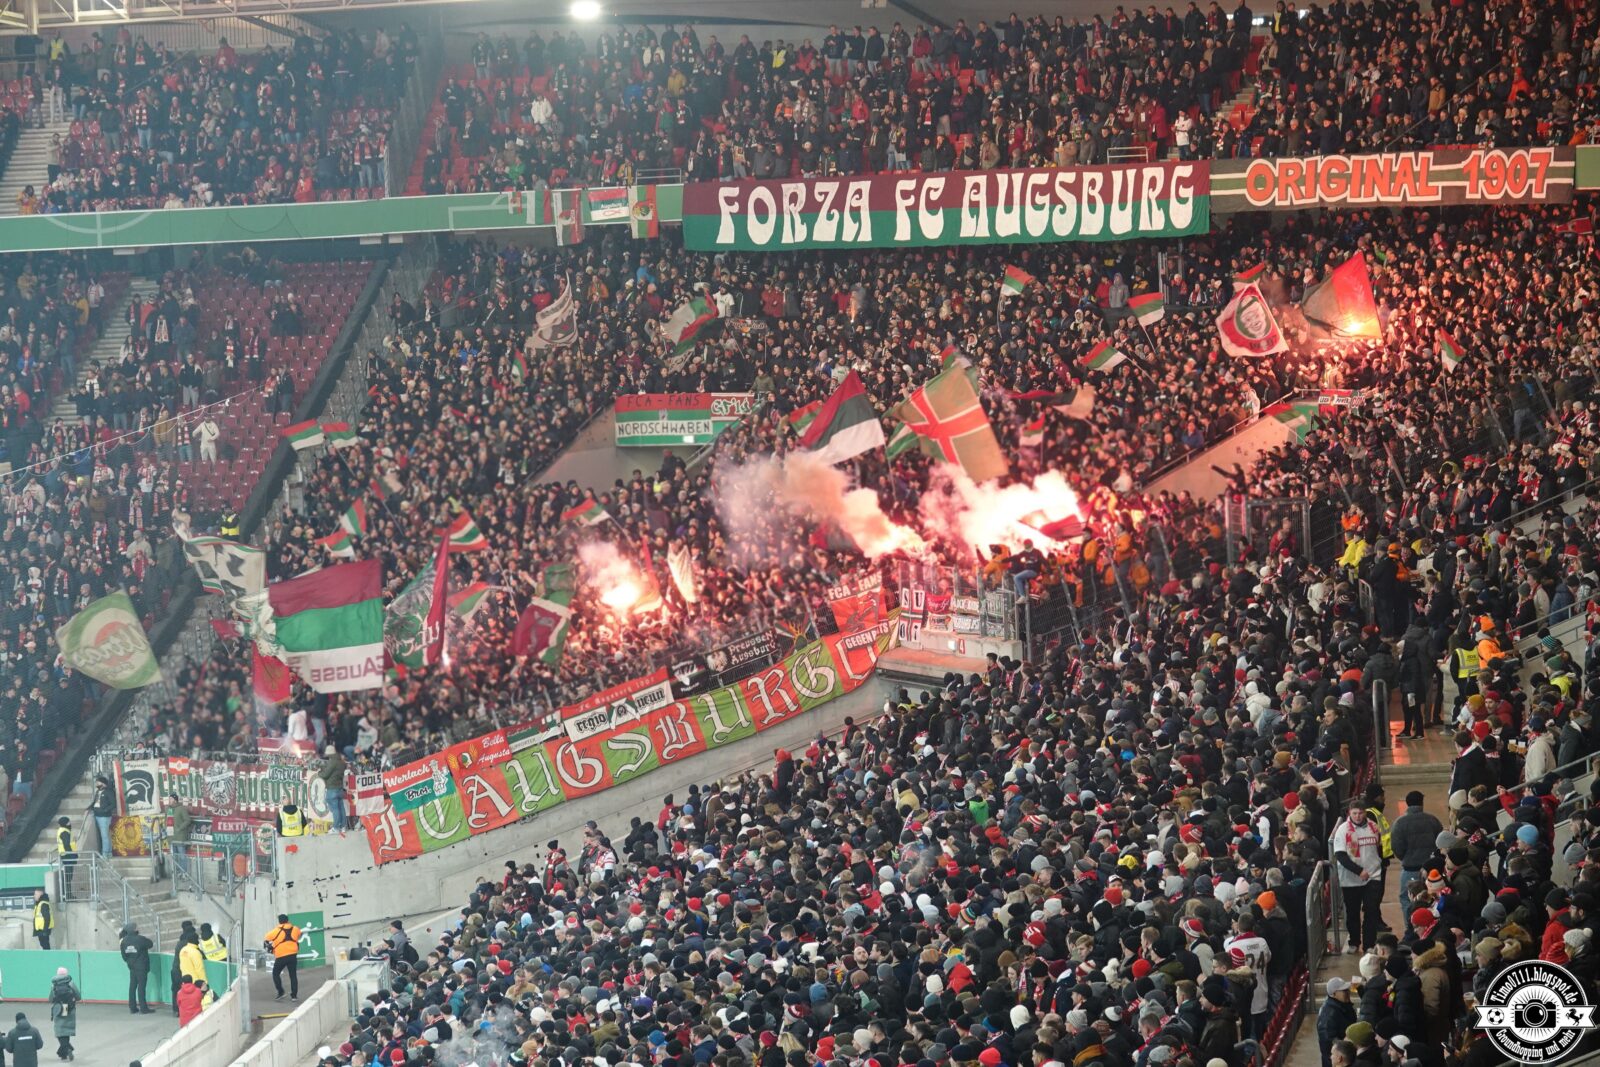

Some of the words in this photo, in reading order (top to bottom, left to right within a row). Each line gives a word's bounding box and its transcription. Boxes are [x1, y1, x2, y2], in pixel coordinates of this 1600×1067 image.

[1246, 153, 1440, 205] ORIGINAL
[1462, 147, 1554, 199] 1907
[716, 181, 872, 245] FORZA
[894, 177, 946, 241] FC
[960, 164, 1193, 239] AUGSBURG
[627, 396, 650, 407] FCA
[668, 394, 700, 406] FANS
[618, 421, 710, 436] NORDSCHWABEN
[828, 585, 851, 600] FCA
[481, 735, 505, 748] Bella
[477, 748, 511, 764] Augusta
[384, 763, 430, 787] Werlach
